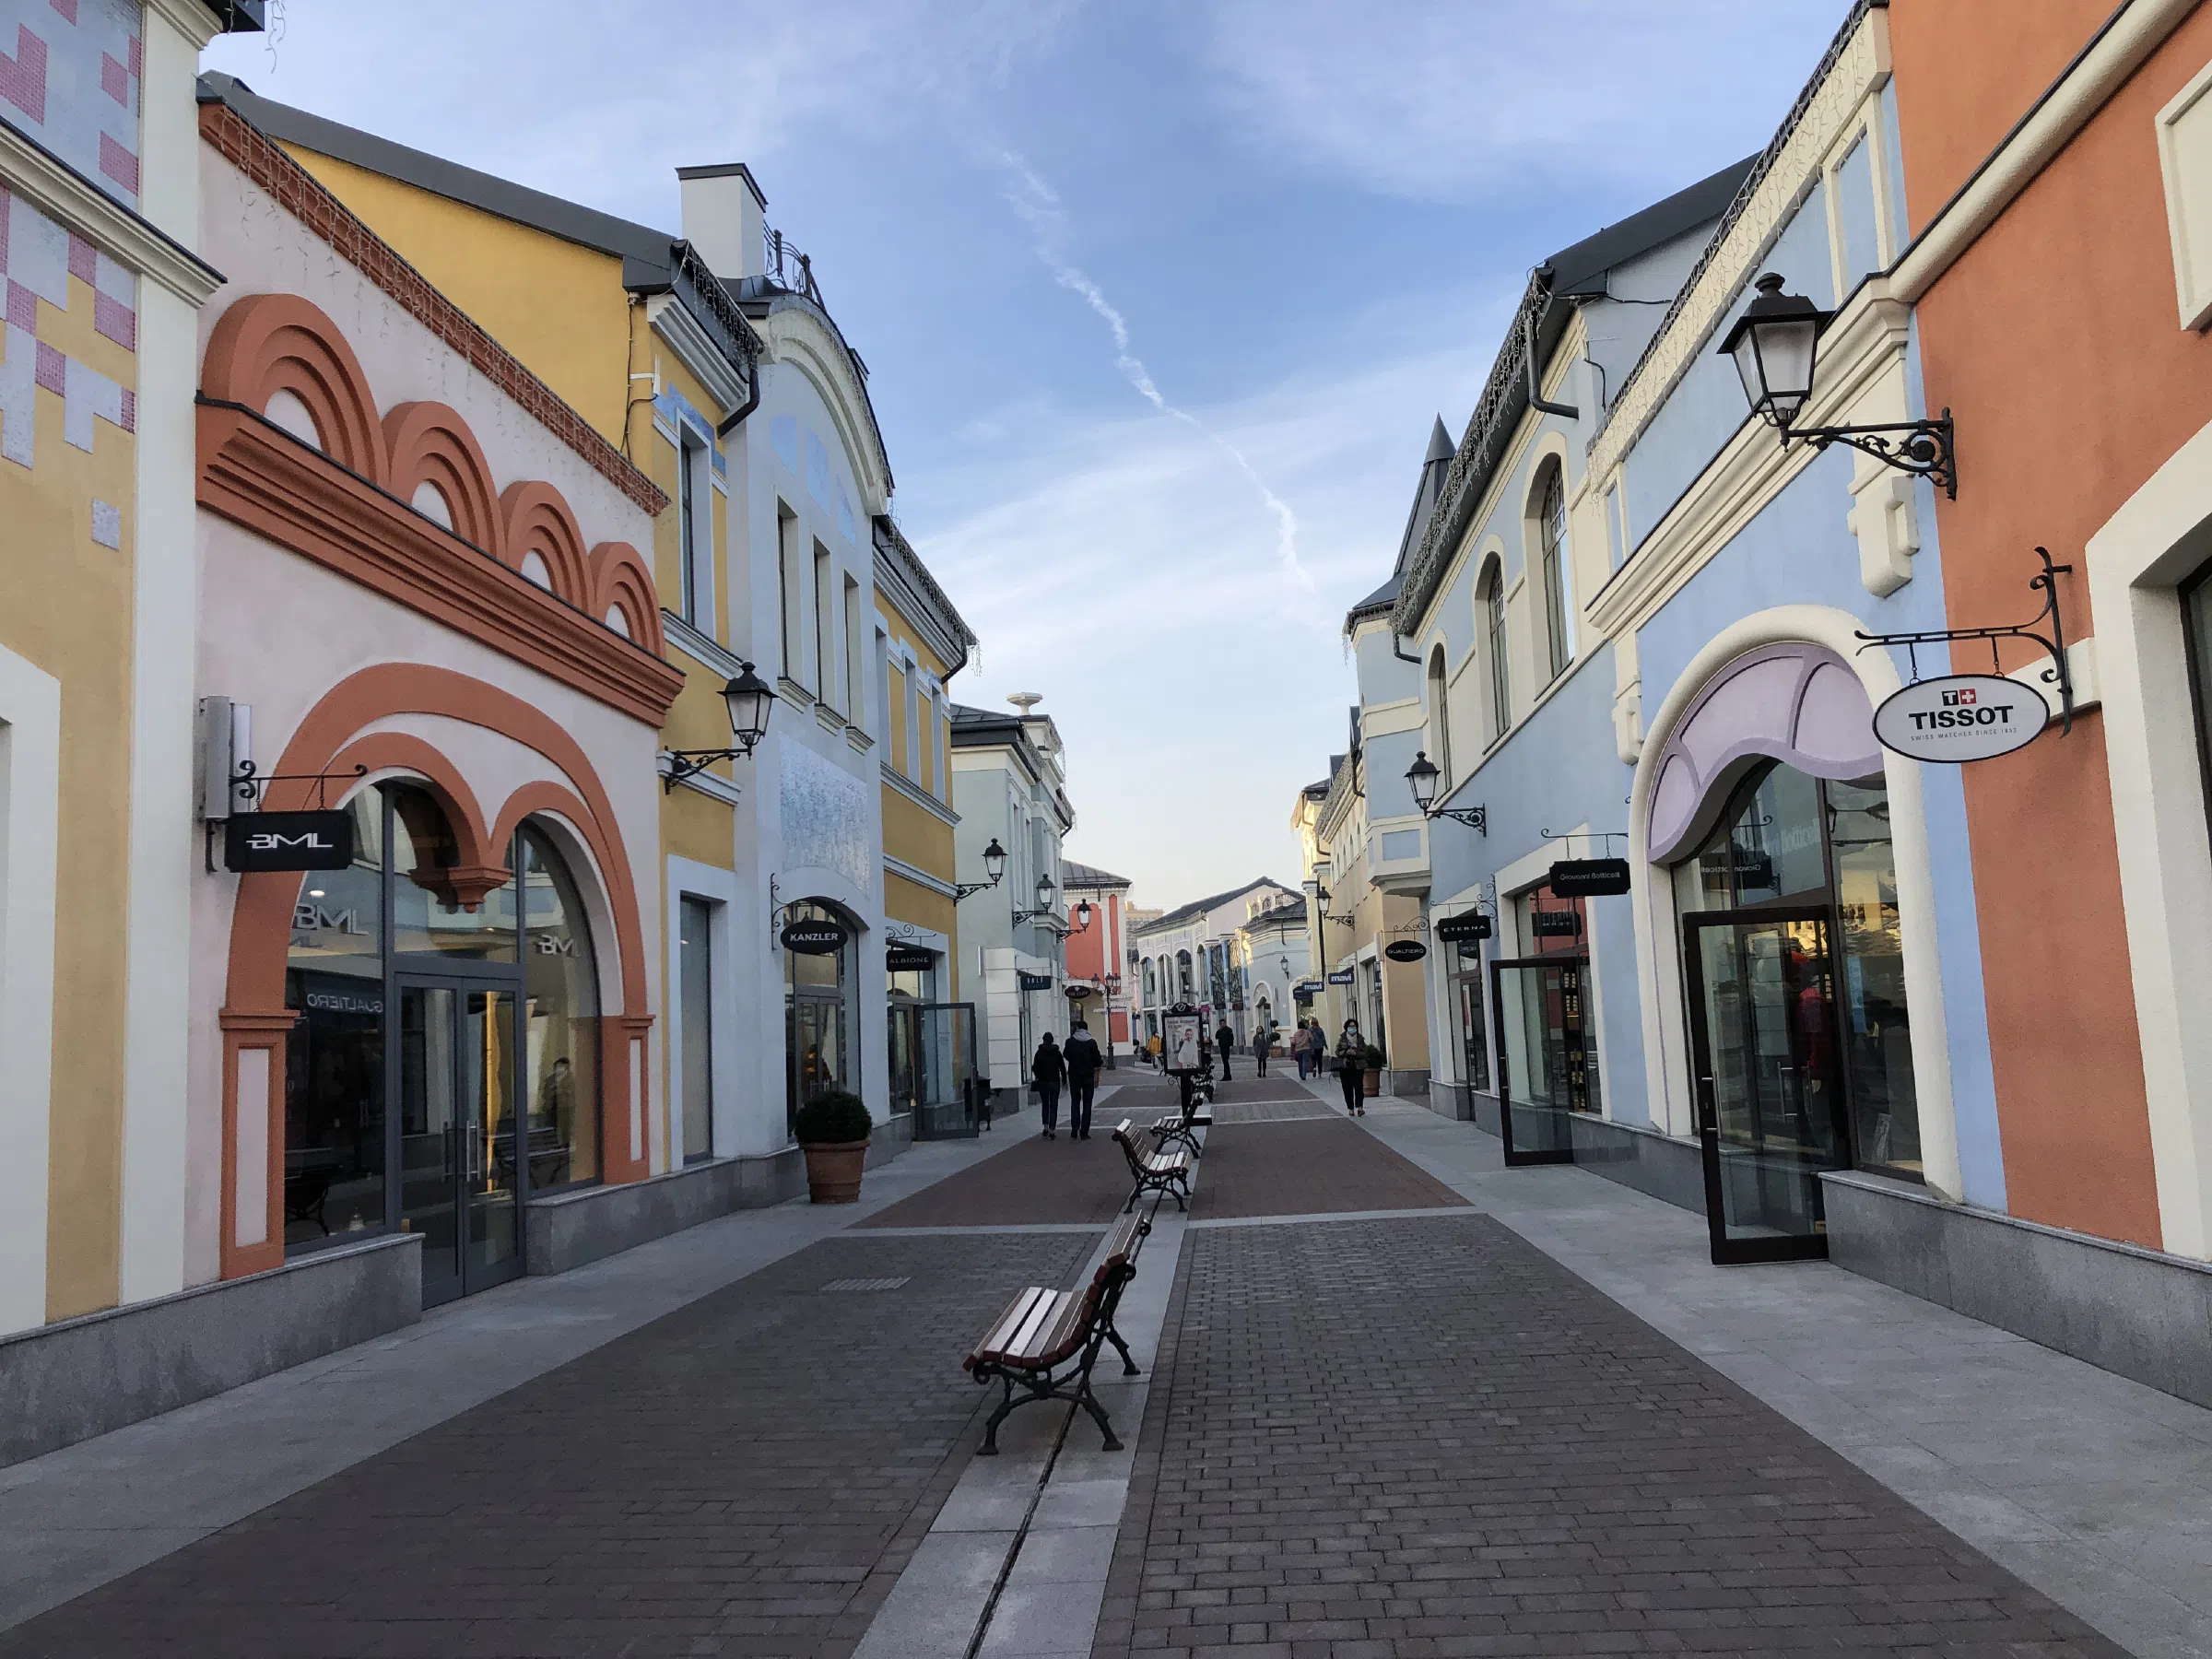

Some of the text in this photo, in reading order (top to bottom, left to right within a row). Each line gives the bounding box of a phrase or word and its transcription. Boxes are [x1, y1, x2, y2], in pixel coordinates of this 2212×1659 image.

[1909, 705, 2014, 729] TISSOT
[1937, 731, 1972, 739] WATCHES
[246, 833, 333, 849] BML
[1559, 871, 1620, 881] Giovanni Botticelli
[293, 903, 370, 935] BML
[790, 933, 839, 941] KANZLER
[1331, 973, 1352, 982] mavi
